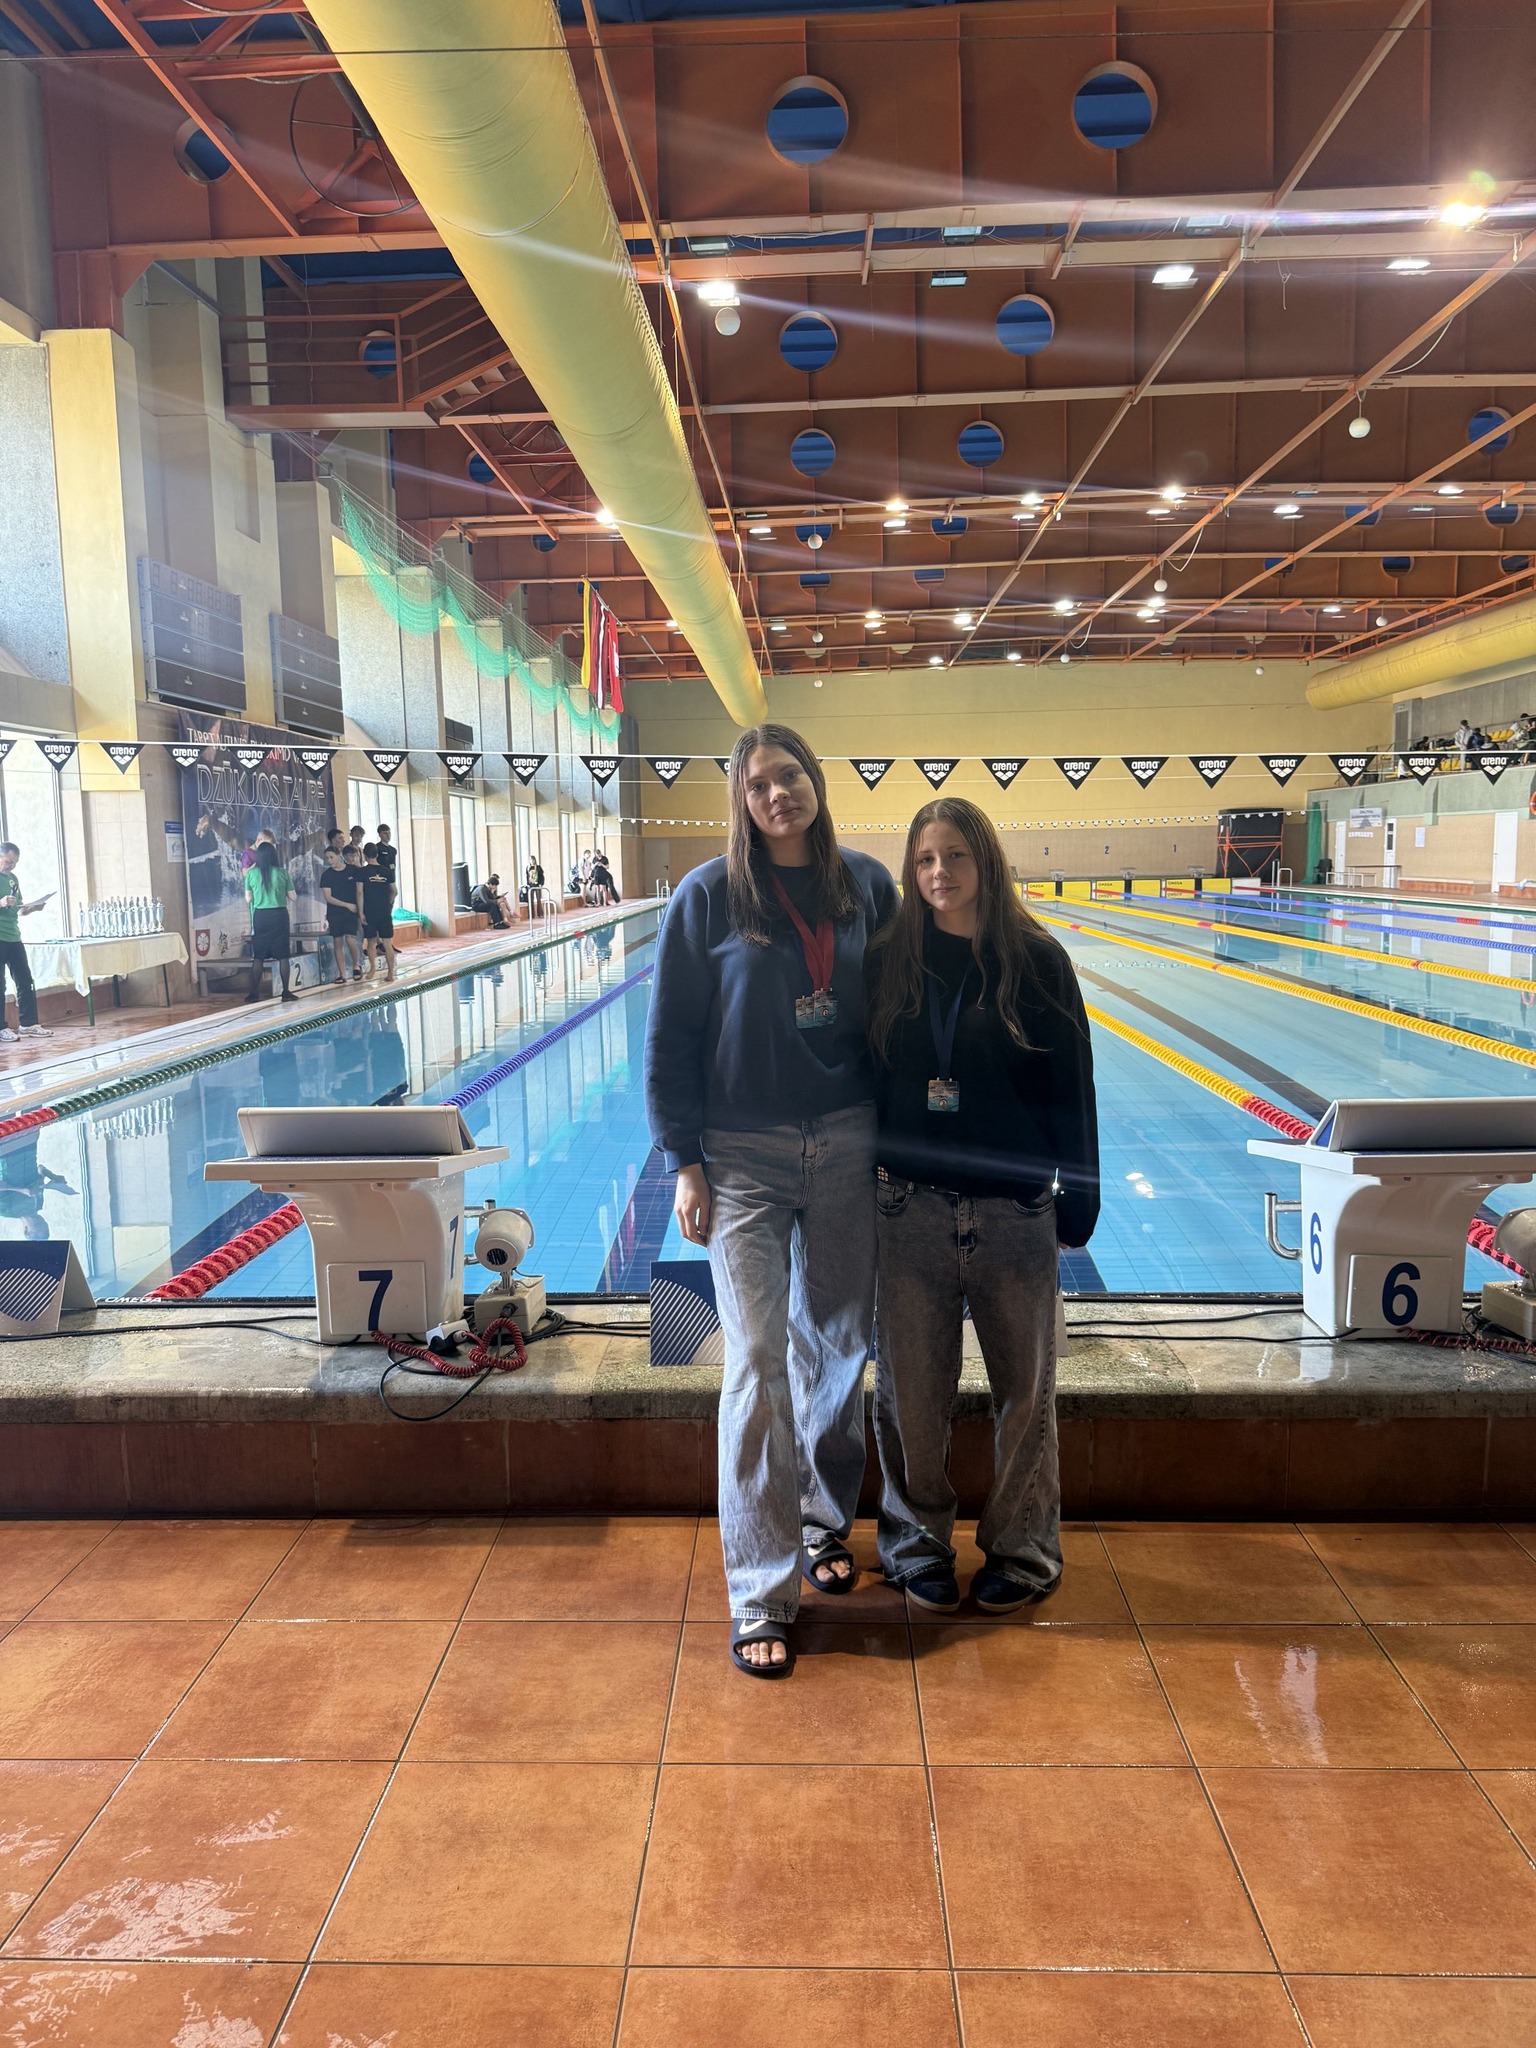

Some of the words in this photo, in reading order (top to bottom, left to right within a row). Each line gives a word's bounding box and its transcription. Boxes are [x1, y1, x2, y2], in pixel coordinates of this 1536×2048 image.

[44, 744, 70, 753] arena
[110, 746, 135, 755] arena
[172, 748, 198, 757] arena
[237, 750, 263, 759] arena
[302, 752, 328, 761] arena
[373, 754, 399, 763] arena
[446, 756, 472, 765] arena
[512, 758, 538, 767] arena
[589, 759, 615, 768] arena
[1199, 760, 1225, 769] arena
[1269, 759, 1295, 768] arena
[1338, 758, 1365, 767] arena
[1409, 758, 1435, 767] arena
[1480, 757, 1506, 766] arena
[655, 761, 681, 770] arena
[859, 763, 884, 772] arena
[924, 762, 949, 771] arena
[992, 762, 1017, 771] arena
[1064, 761, 1090, 770] arena
[1131, 761, 1157, 770] arena
[1044, 846, 1049, 856] 3
[1104, 846, 1110, 855] 2
[295, 963, 301, 986] 2
[450, 1215, 459, 1280] 7
[1310, 1212, 1322, 1274] 6
[1382, 1262, 1421, 1326] 6
[359, 1270, 392, 1331] 7
